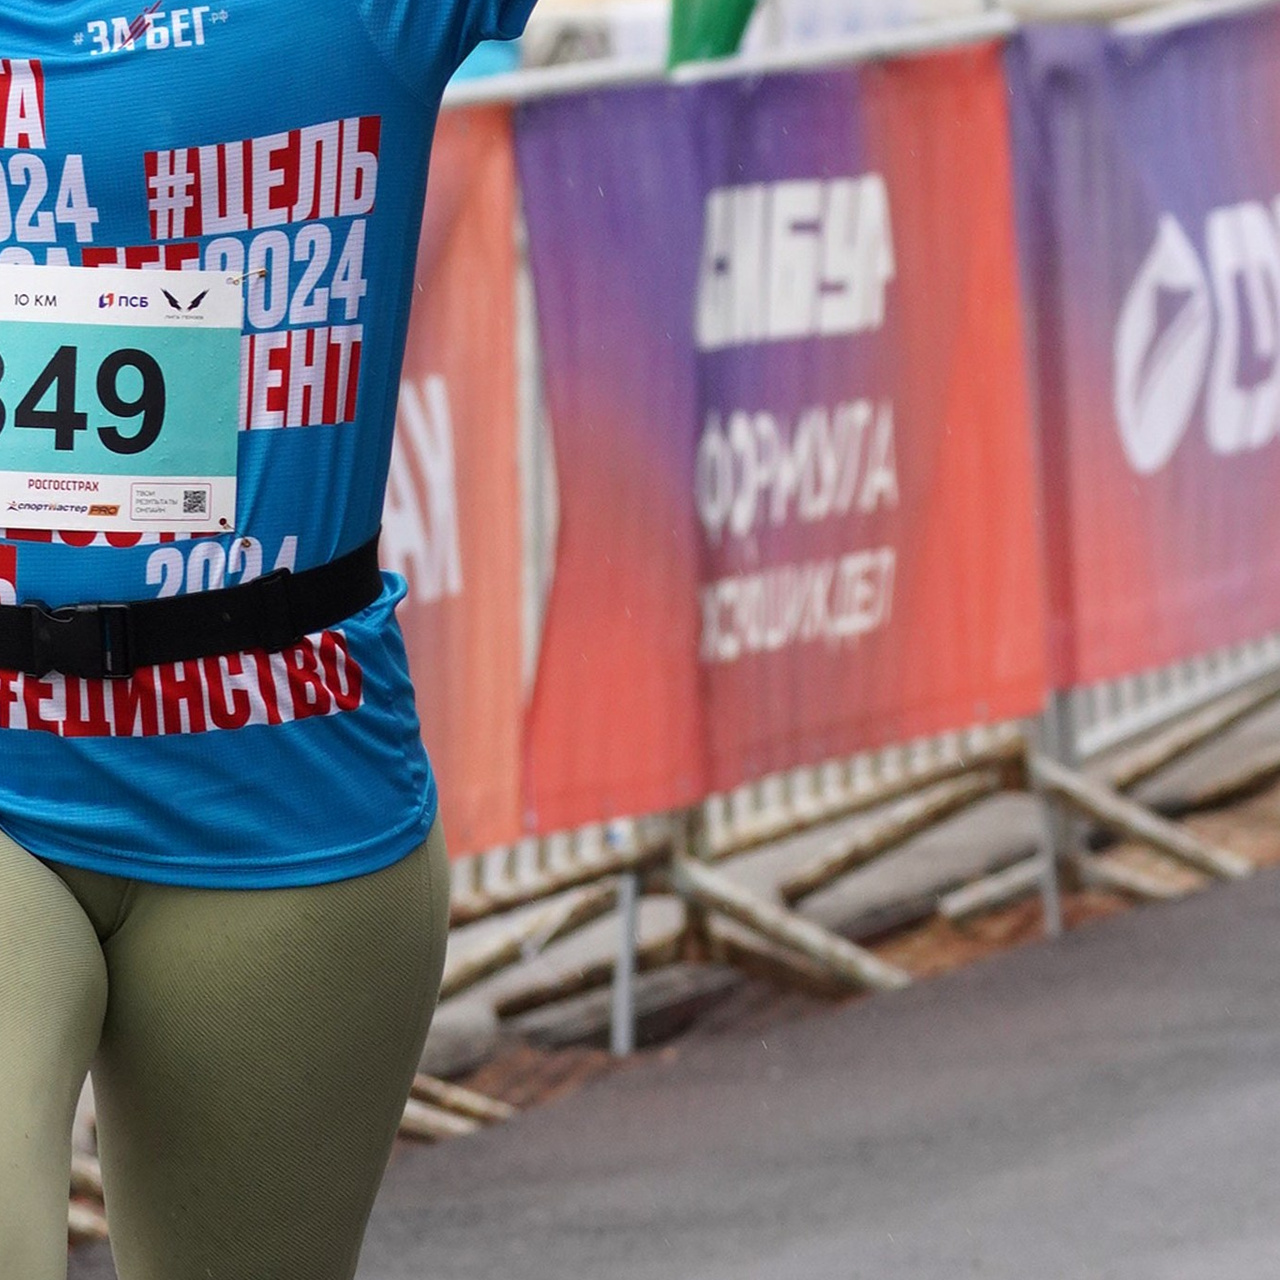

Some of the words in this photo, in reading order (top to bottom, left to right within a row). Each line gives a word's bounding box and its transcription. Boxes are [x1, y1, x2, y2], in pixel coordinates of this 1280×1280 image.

[147, 116, 381, 240] #ЦЕЛЬ
[14, 293, 30, 306] 10
[34, 294, 58, 308] КМ
[118, 295, 149, 308] ПСБ
[27, 478, 100, 492] РОСГОССТРАХ
